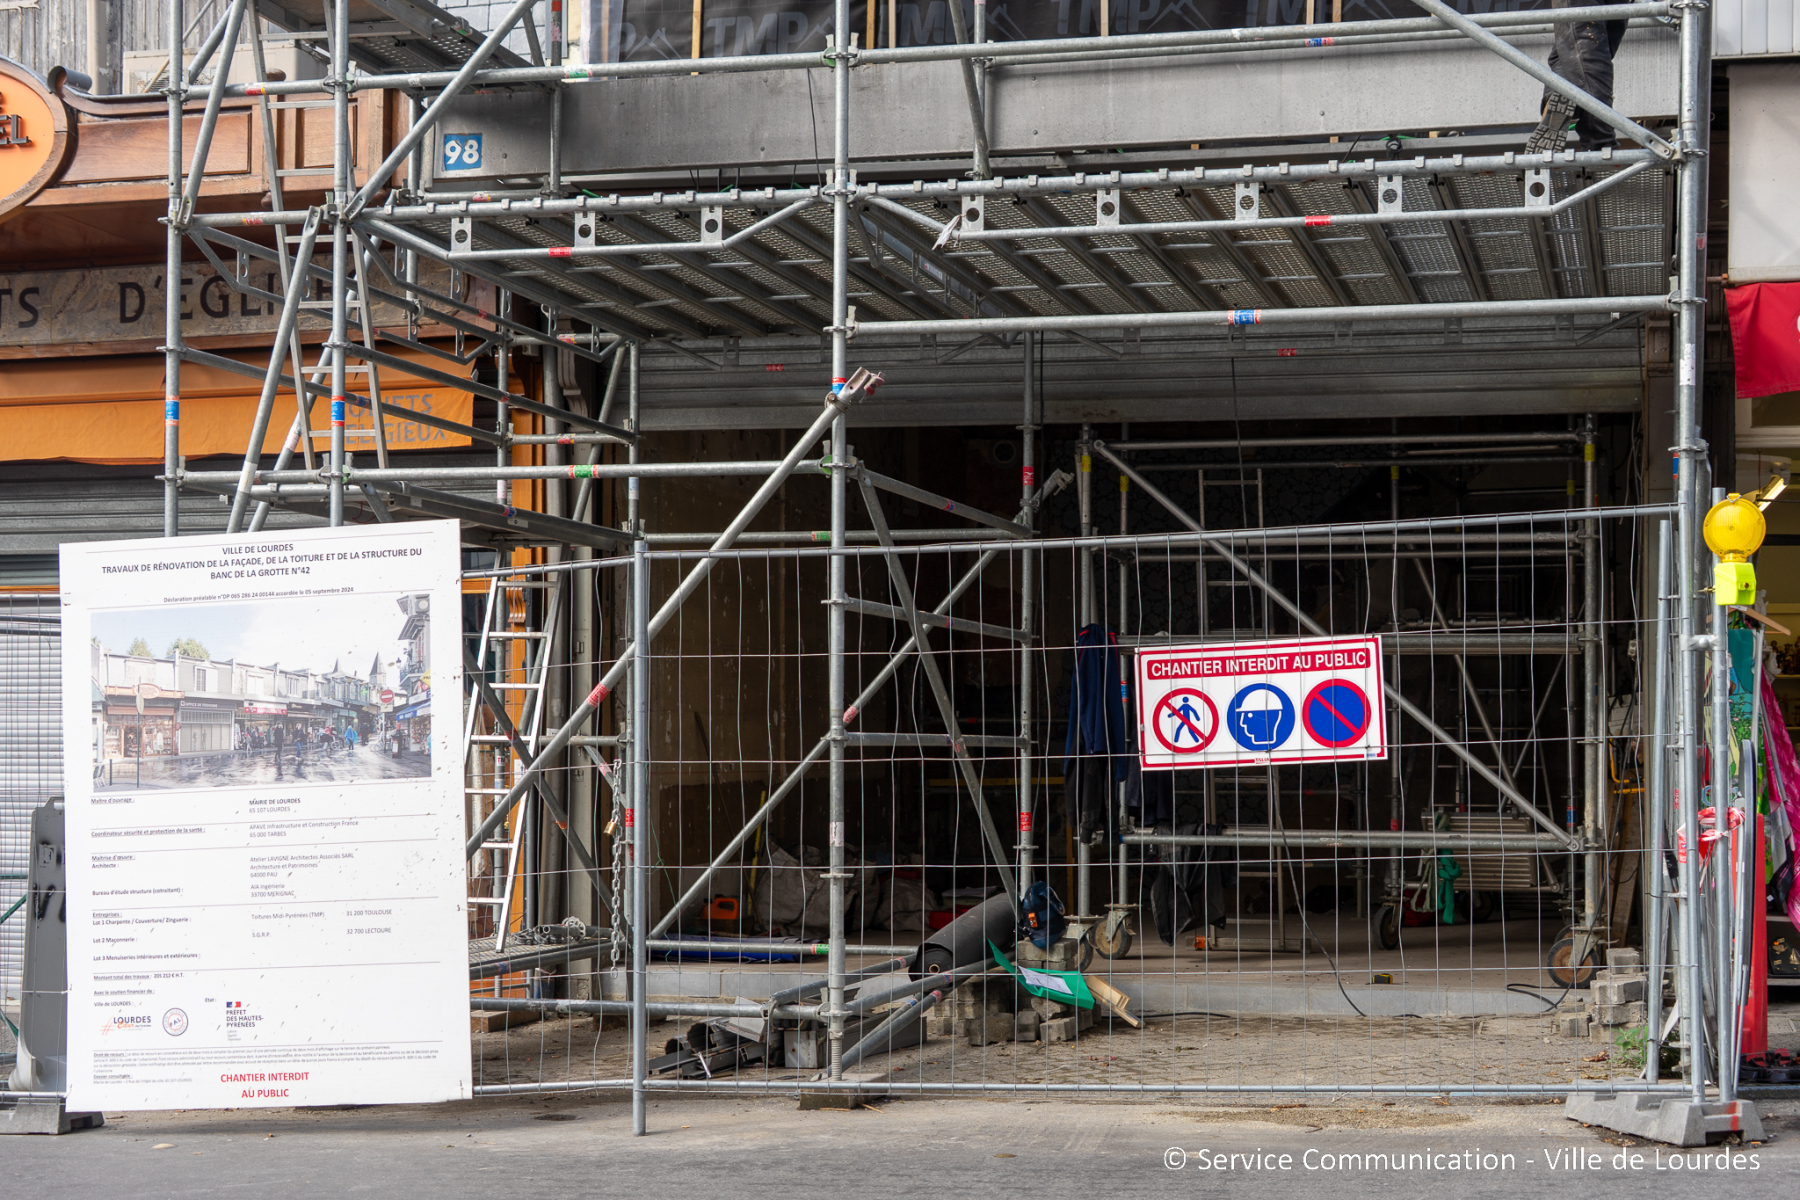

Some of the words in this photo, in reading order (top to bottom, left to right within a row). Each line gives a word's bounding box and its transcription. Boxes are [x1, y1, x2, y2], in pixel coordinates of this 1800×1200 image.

[706, 12, 809, 57] TMP
[444, 139, 481, 165] 98
[222, 546, 243, 554] VILLE
[257, 543, 294, 552] LOURDES
[102, 564, 139, 573] TRAVAUX
[153, 560, 205, 570] RÉNOVATION
[231, 557, 264, 567] FAÇADE,
[266, 556, 276, 564] DE
[290, 553, 324, 563] TOITURE
[362, 548, 408, 558] STRUCTURE
[210, 571, 233, 579] BANC
[258, 568, 290, 576] GROTTE
[291, 566, 310, 574] N°42
[1151, 660, 1222, 678] CHANTIER
[1226, 656, 1288, 674] INTERDIT
[1292, 654, 1311, 669] AU
[1315, 650, 1367, 668] PUBLIC
[114, 1015, 151, 1024] LOURDES
[220, 1073, 265, 1082] CHANTIER
[268, 1072, 310, 1081] INTERDIT
[241, 1090, 255, 1098] AU
[257, 1088, 289, 1098] PUBLIC
